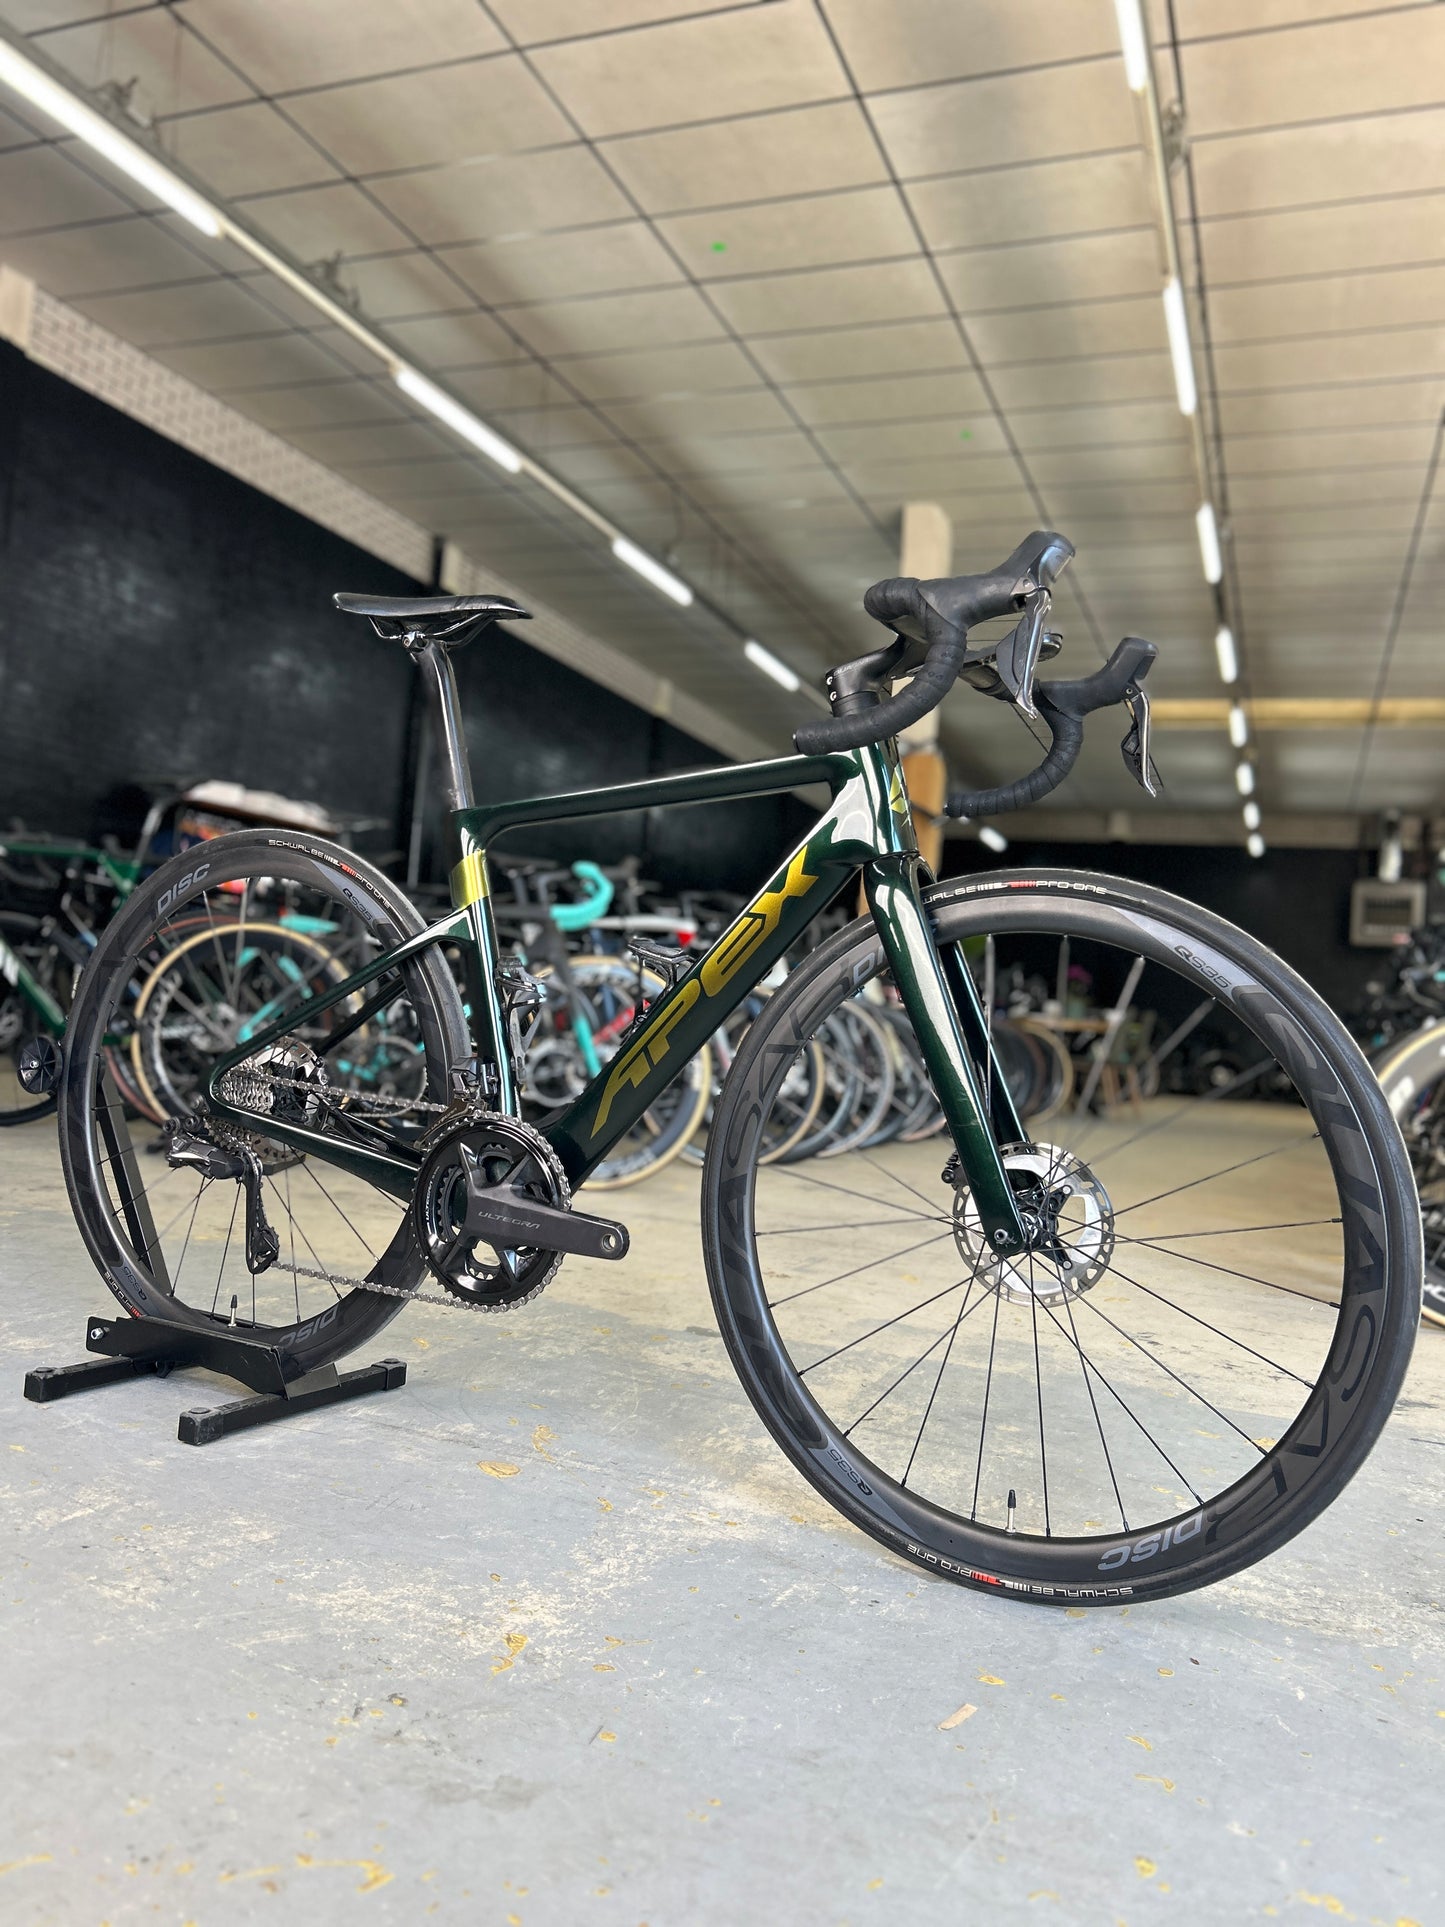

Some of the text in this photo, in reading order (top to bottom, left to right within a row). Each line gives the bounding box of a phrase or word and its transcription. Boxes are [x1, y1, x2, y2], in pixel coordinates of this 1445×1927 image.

[268, 839, 324, 859] SCHWALBE
[157, 863, 211, 915] DISC
[922, 884, 977, 905] WALBE
[590, 845, 819, 1139] APEX
[477, 1211, 541, 1229] ULTEGRA
[279, 1304, 339, 1349] DISC
[1097, 1510, 1203, 1571] DISC
[1031, 1586, 1133, 1599] SCHWALBE
